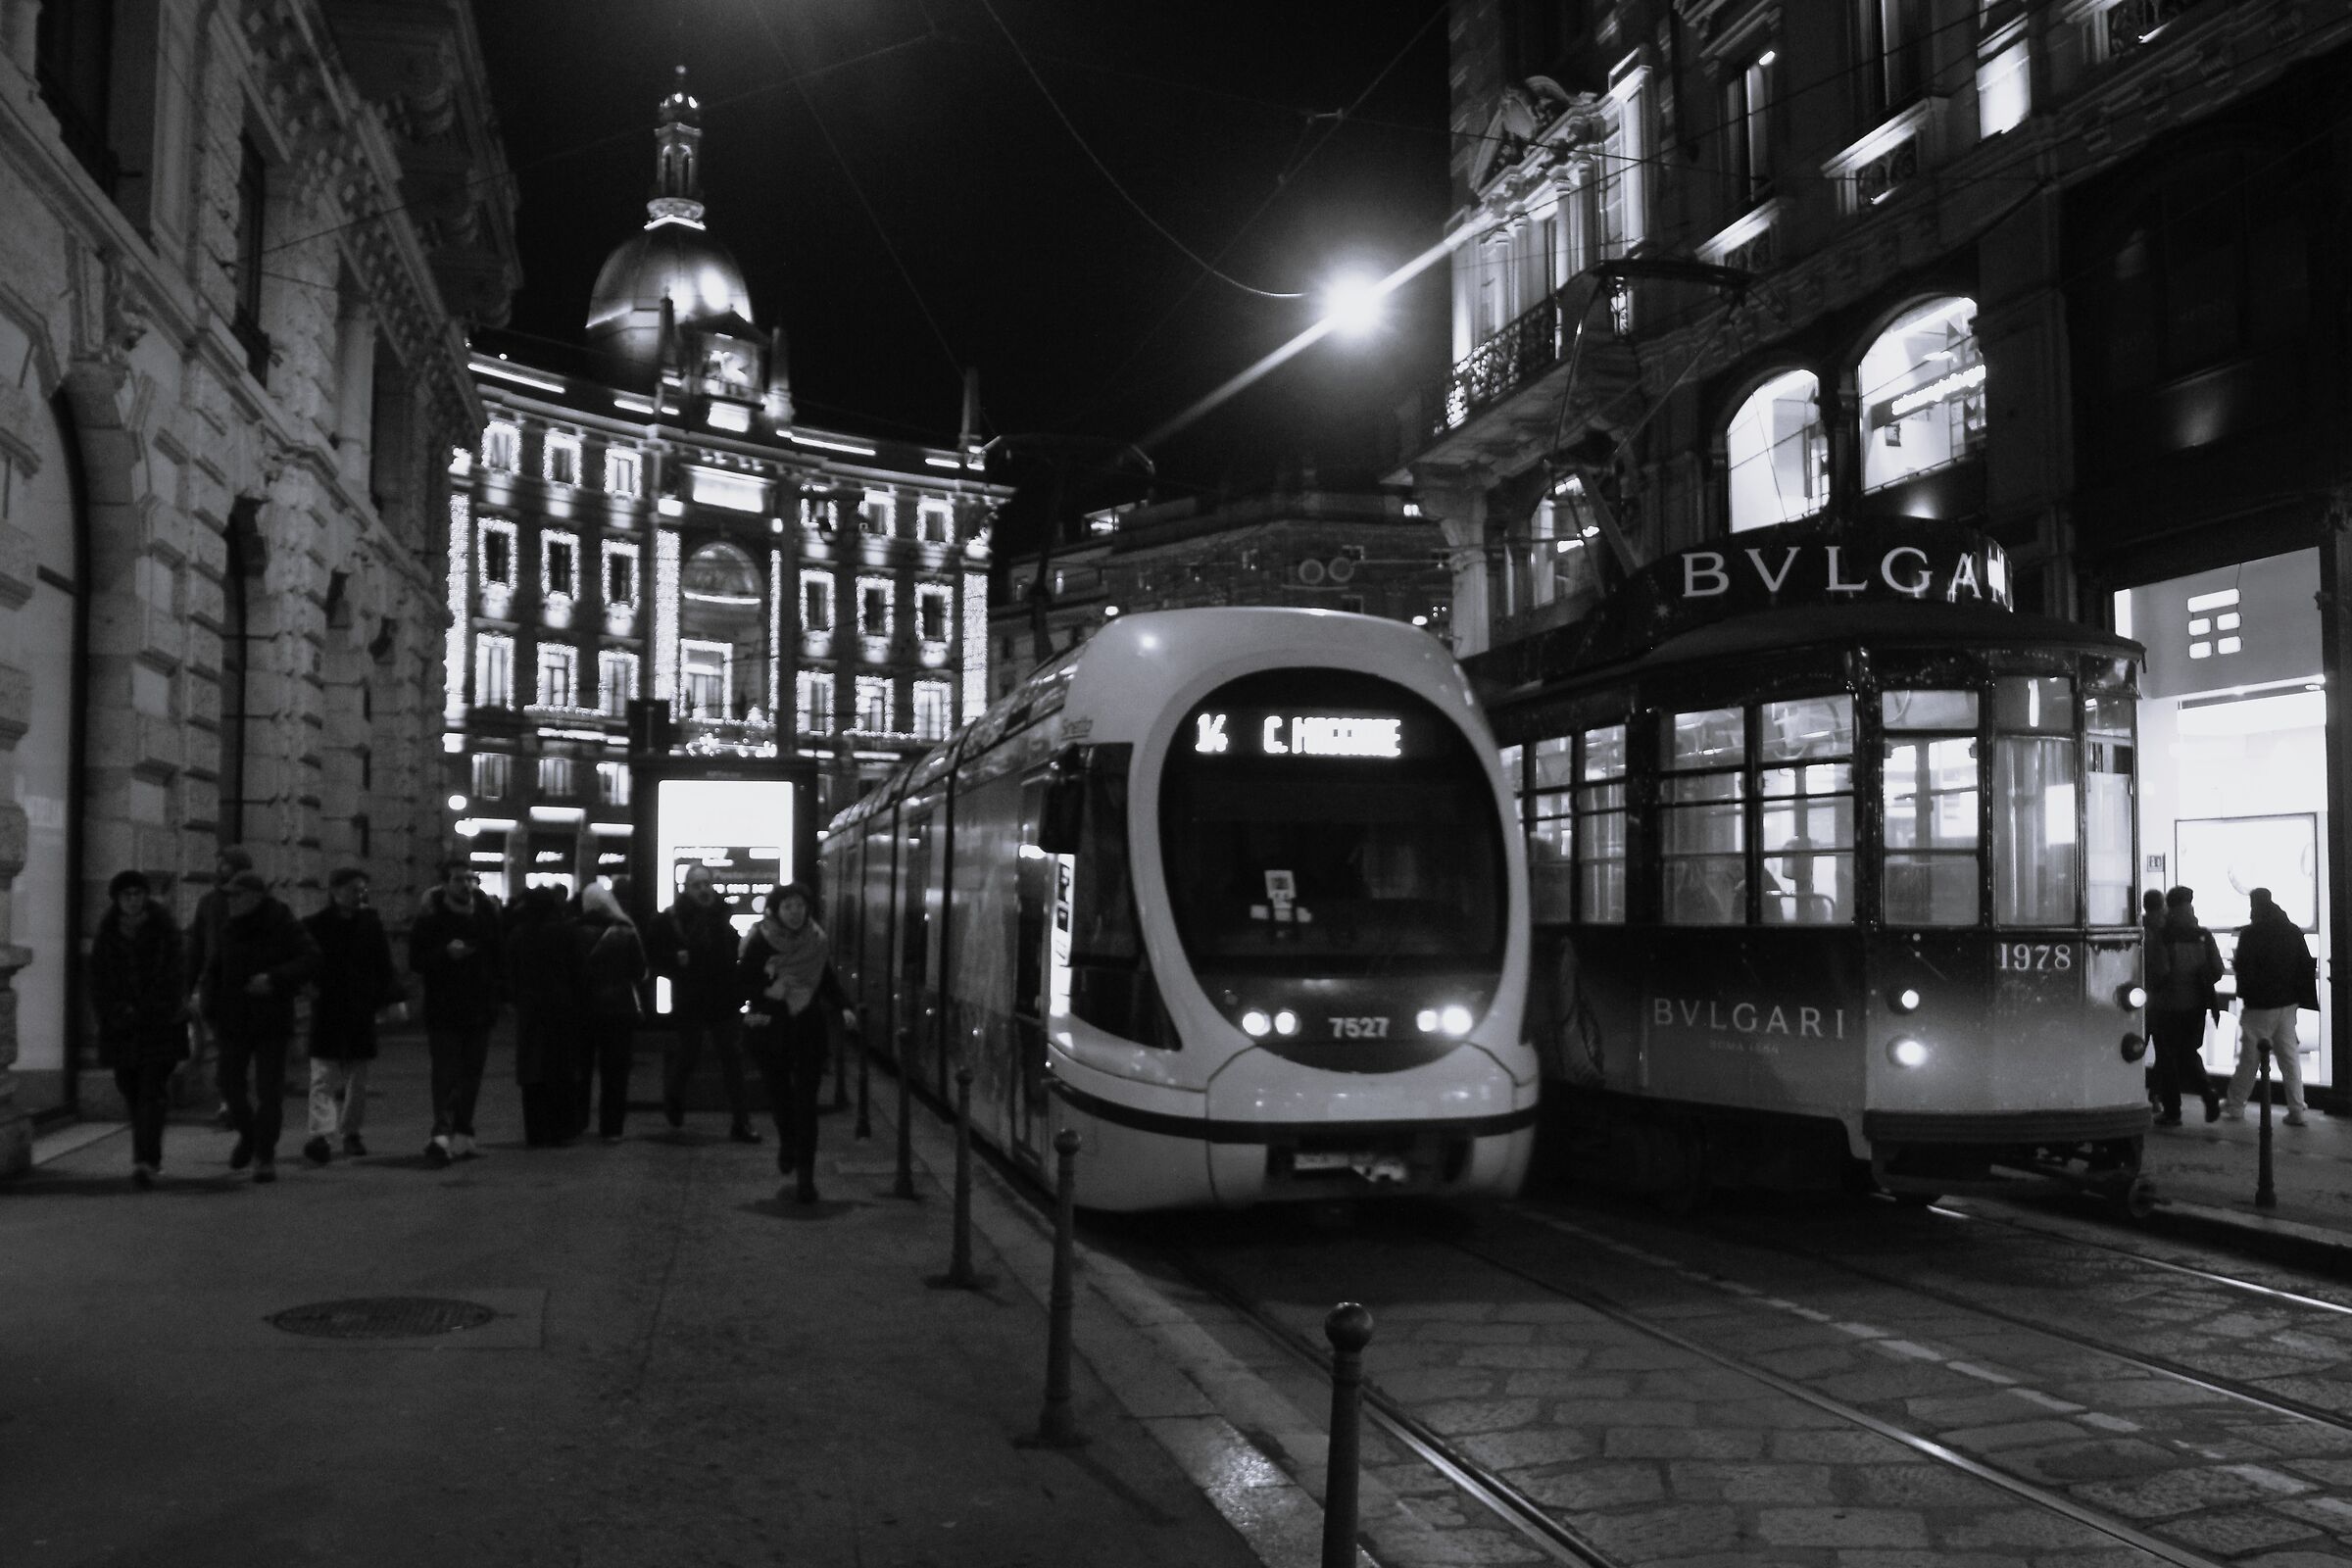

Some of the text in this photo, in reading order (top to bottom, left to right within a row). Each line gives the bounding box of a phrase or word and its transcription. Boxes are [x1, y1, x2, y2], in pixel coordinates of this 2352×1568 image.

[2000, 943, 2071, 970] 1978
[1328, 1016, 1390, 1038] 7527
[1654, 998, 1843, 1039] BVLGARI
